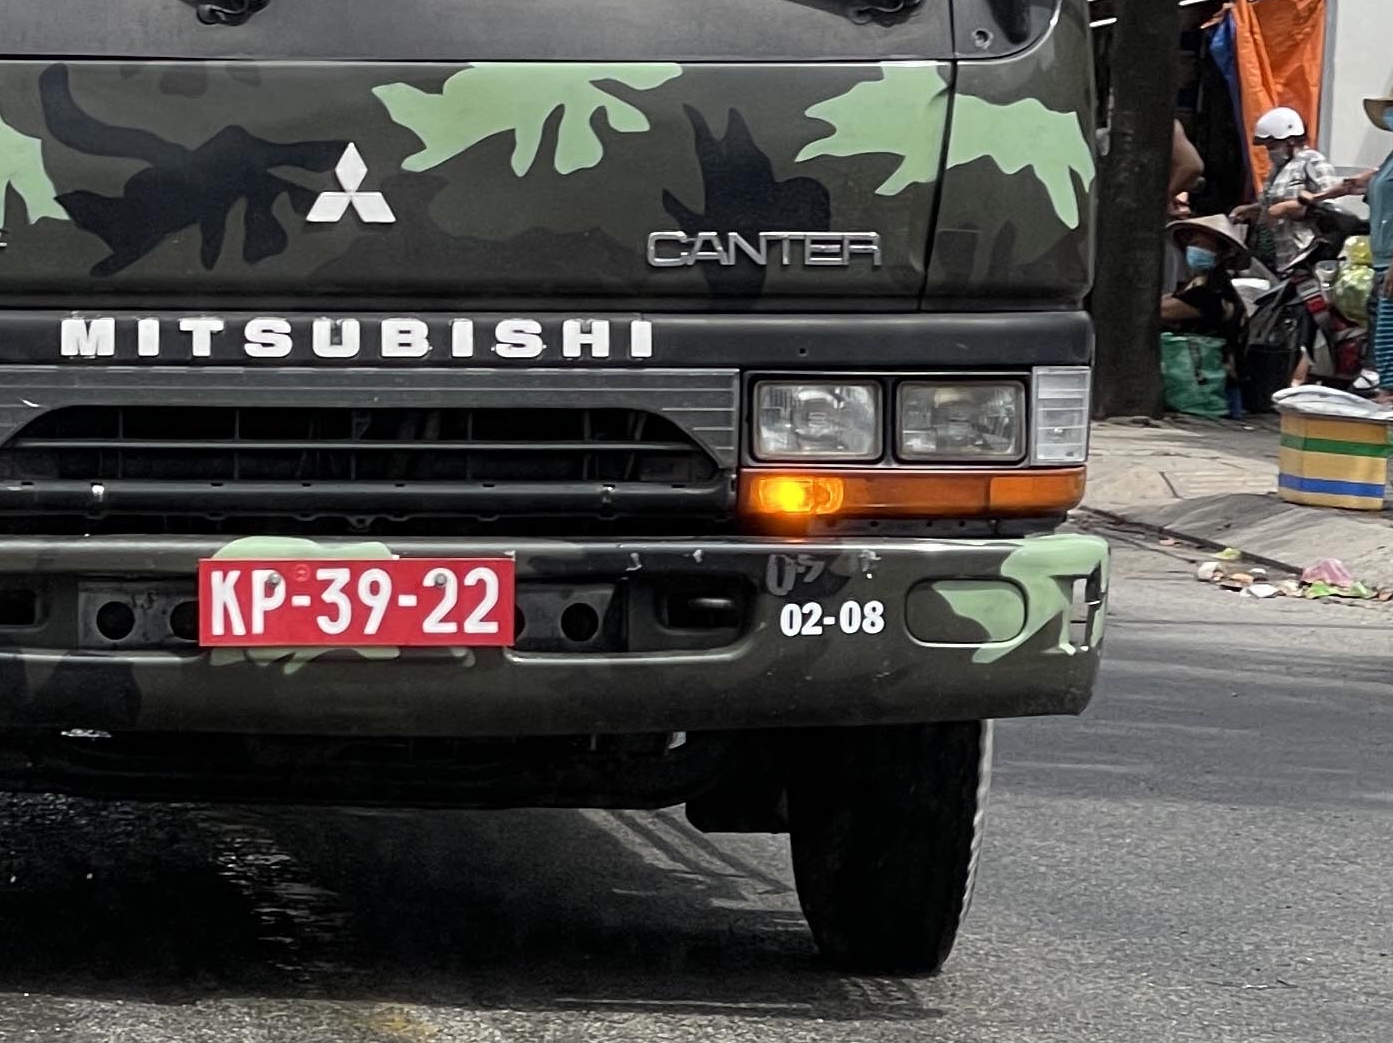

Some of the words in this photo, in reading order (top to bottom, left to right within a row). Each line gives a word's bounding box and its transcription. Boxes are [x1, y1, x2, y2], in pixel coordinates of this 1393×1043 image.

[647, 231, 882, 267] CANTER
[61, 317, 653, 358] MITSUBISHI
[211, 567, 499, 636] KP-39-22
[780, 600, 885, 637] 02-08
